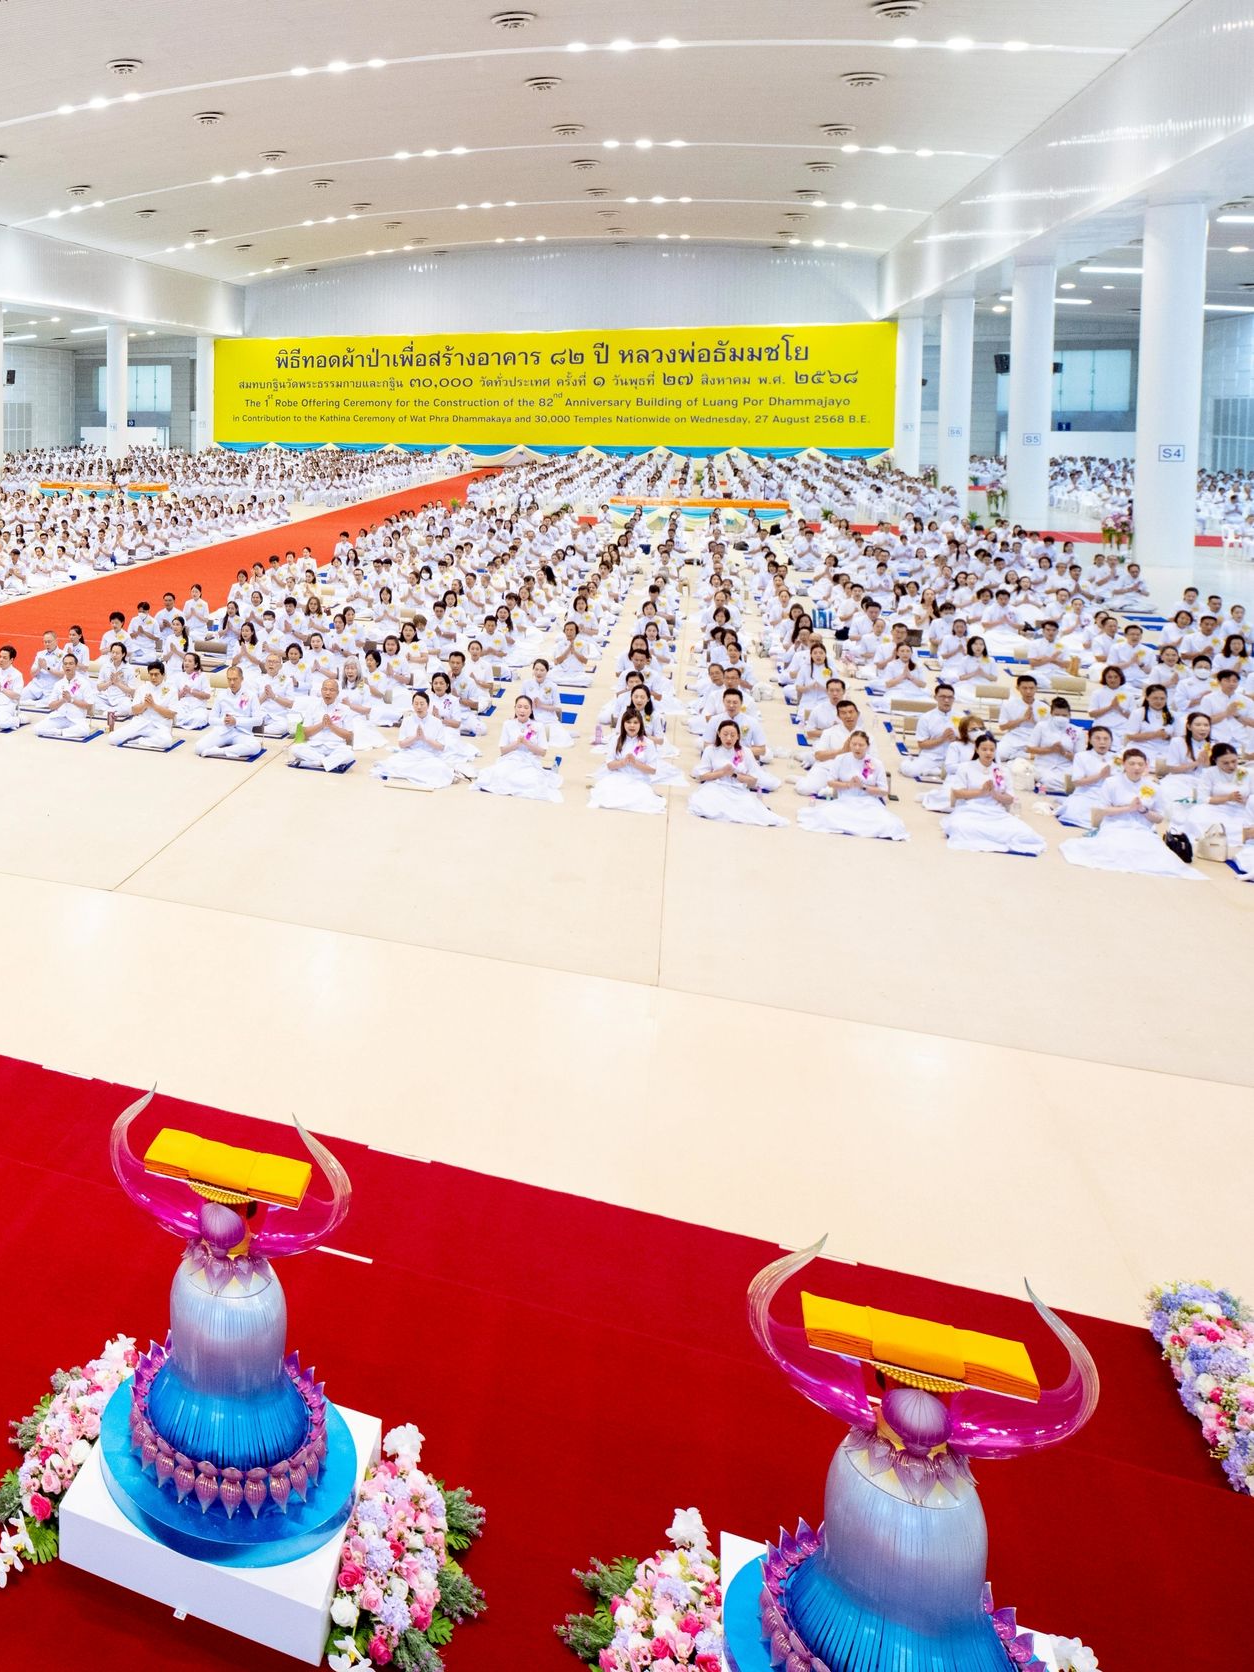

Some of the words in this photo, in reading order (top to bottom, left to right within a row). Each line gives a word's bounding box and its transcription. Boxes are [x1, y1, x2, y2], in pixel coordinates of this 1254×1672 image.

[275, 341, 541, 368] พิธีทอดผ้าป่าเพื่อสร้างอาคาร
[551, 348, 584, 365] ๘๒
[593, 342, 609, 364] ปี
[618, 334, 808, 364] หลวงพ่อธัมมชโย
[592, 377, 606, 387] ๑
[662, 372, 694, 385] ๒๗
[700, 373, 751, 385] สิงหาคม
[794, 370, 859, 384] ๒๕๖๘
[244, 398, 261, 408] The
[274, 398, 299, 408] Robe
[301, 399, 341, 409] Offering
[342, 398, 393, 409] Ceremony
[395, 398, 411, 408] for
[413, 398, 430, 407] the
[433, 398, 500, 408] Construction
[503, 398, 514, 408] of
[517, 397, 535, 408] the
[564, 398, 632, 408] Anniversary
[635, 398, 683, 408] Building
[686, 397, 699, 407] of
[702, 398, 739, 408] Luang
[742, 396, 764, 407] Por
[768, 397, 851, 408] Dhammajayo
[241, 414, 291, 422] Contribution
[304, 414, 318, 422] the
[319, 414, 351, 422] Kathina
[352, 414, 396, 424] Ceremony
[398, 414, 407, 423] of
[409, 414, 427, 423] Wat
[429, 414, 450, 423] Phra
[452, 414, 512, 425] Dhammakaya
[514, 415, 532, 423] and
[574, 415, 613, 425] Temples
[615, 415, 671, 424] Nationwide
[673, 416, 687, 424] on
[754, 414, 769, 424] 27
[772, 415, 810, 426] August
[813, 414, 845, 424] 2568
[1162, 448, 1181, 458] S4
